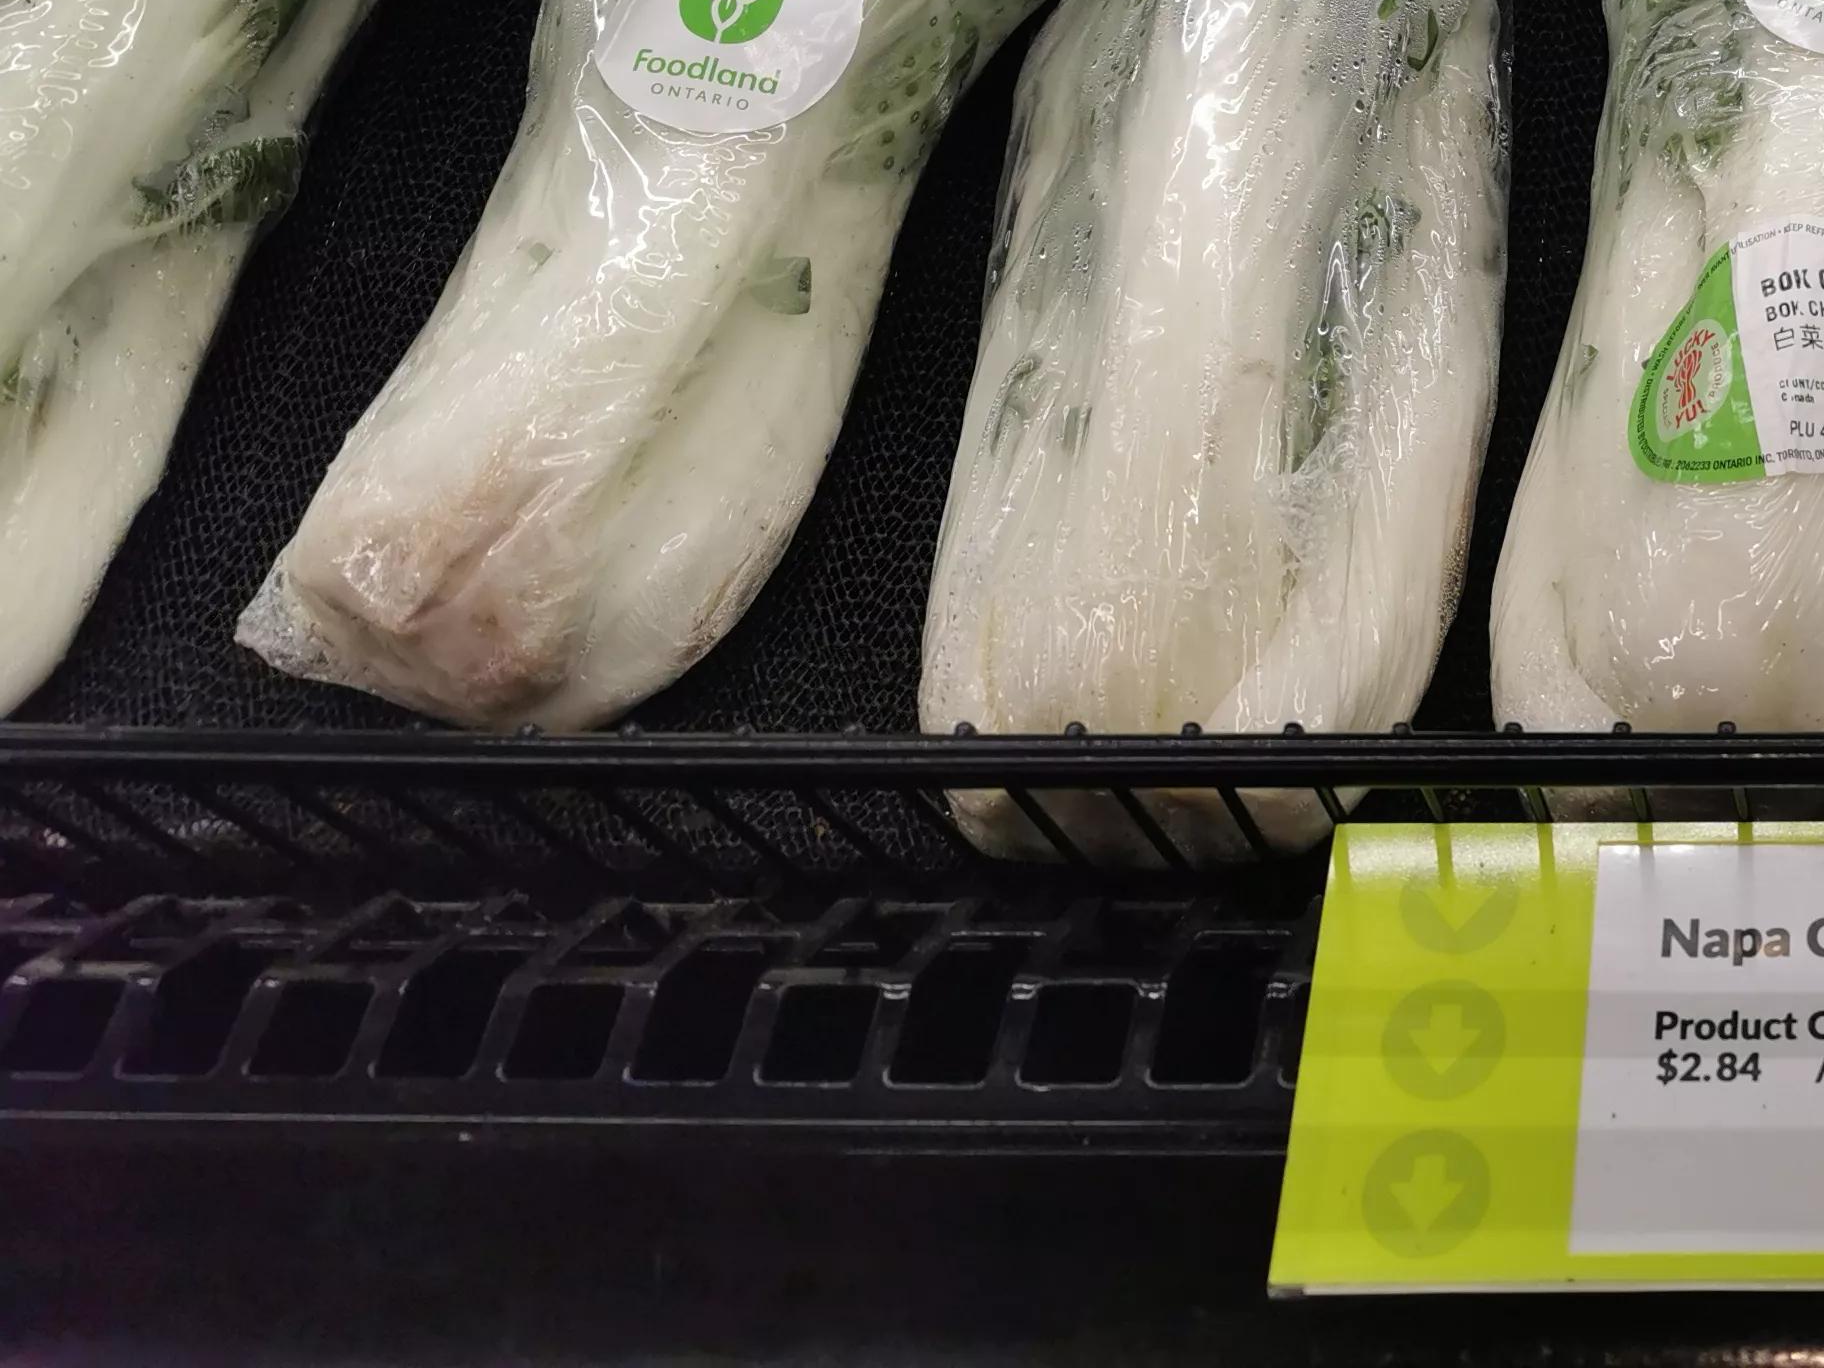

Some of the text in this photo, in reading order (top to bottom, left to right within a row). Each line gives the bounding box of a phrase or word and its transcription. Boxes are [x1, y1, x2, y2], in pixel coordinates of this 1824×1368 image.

[632, 48, 781, 95] Foodland
[651, 82, 750, 111] ONTARIO
[1761, 268, 1811, 298] BOK
[1765, 300, 1804, 322] BOK
[1773, 324, 1824, 351] 白菜
[1789, 420, 1815, 438] PLU
[1712, 456, 1752, 470] ONTARIO
[1660, 917, 1792, 967] Napa
[1654, 1010, 1798, 1040] Product
[1656, 1049, 1762, 1087] $2.84
